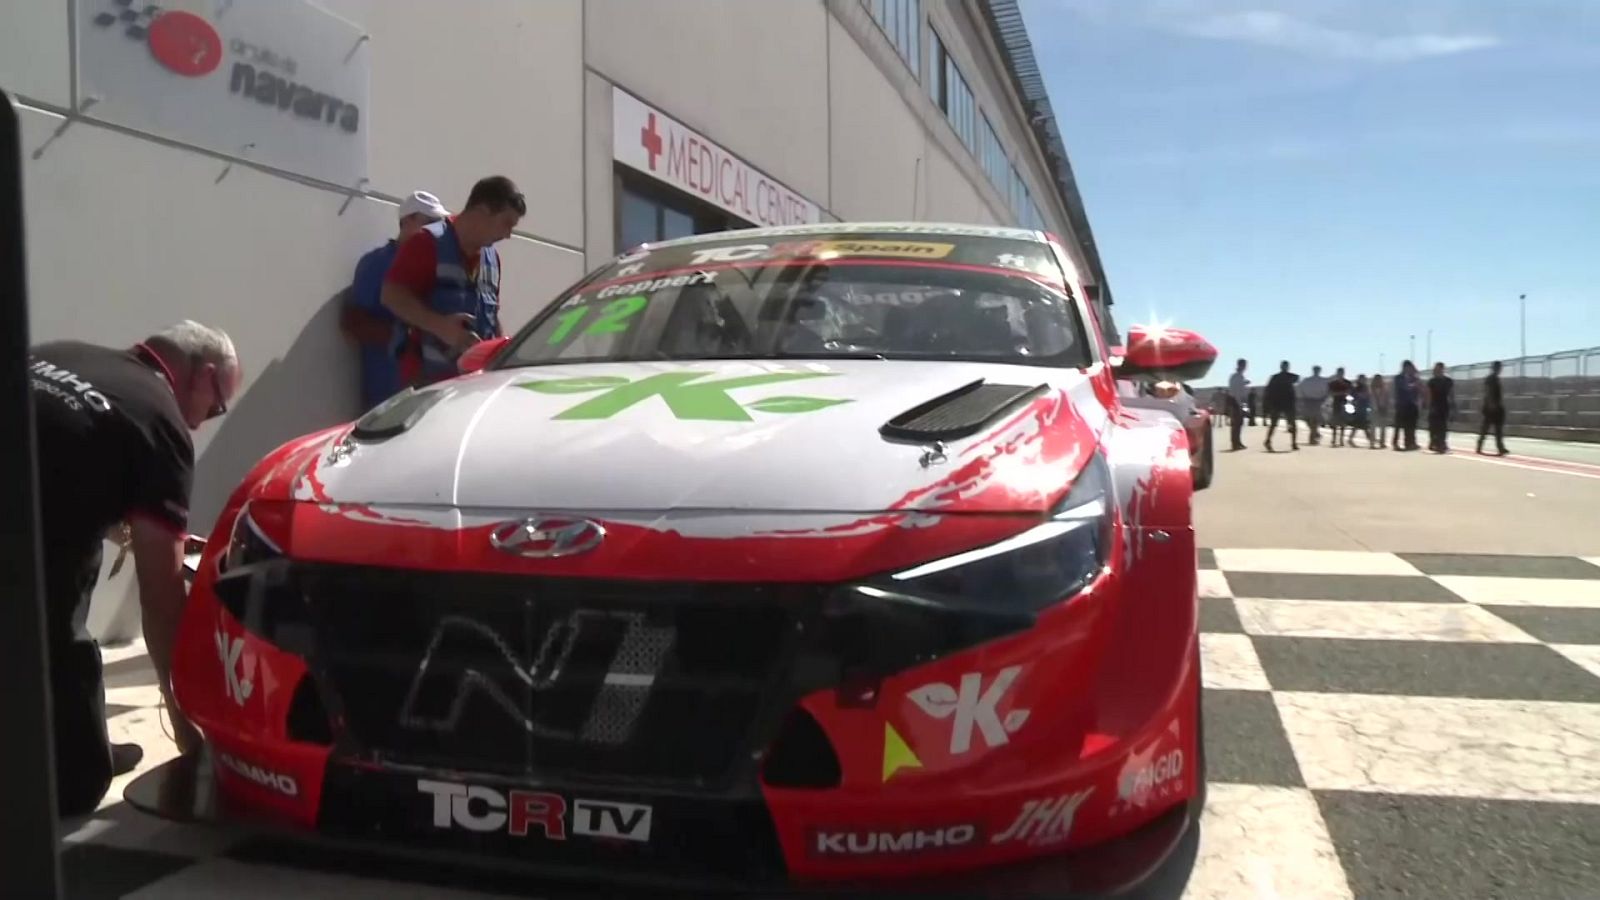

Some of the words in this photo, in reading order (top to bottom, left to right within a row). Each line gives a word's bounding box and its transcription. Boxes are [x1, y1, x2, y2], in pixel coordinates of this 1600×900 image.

[230, 62, 359, 133] navarra
[667, 126, 751, 214] MEDICAL
[831, 242, 936, 255] Spain
[547, 295, 648, 345] 12
[417, 779, 566, 840] TCR
[577, 803, 648, 835] TV
[817, 824, 975, 853] KUMHO
[991, 785, 1097, 843] JHK
